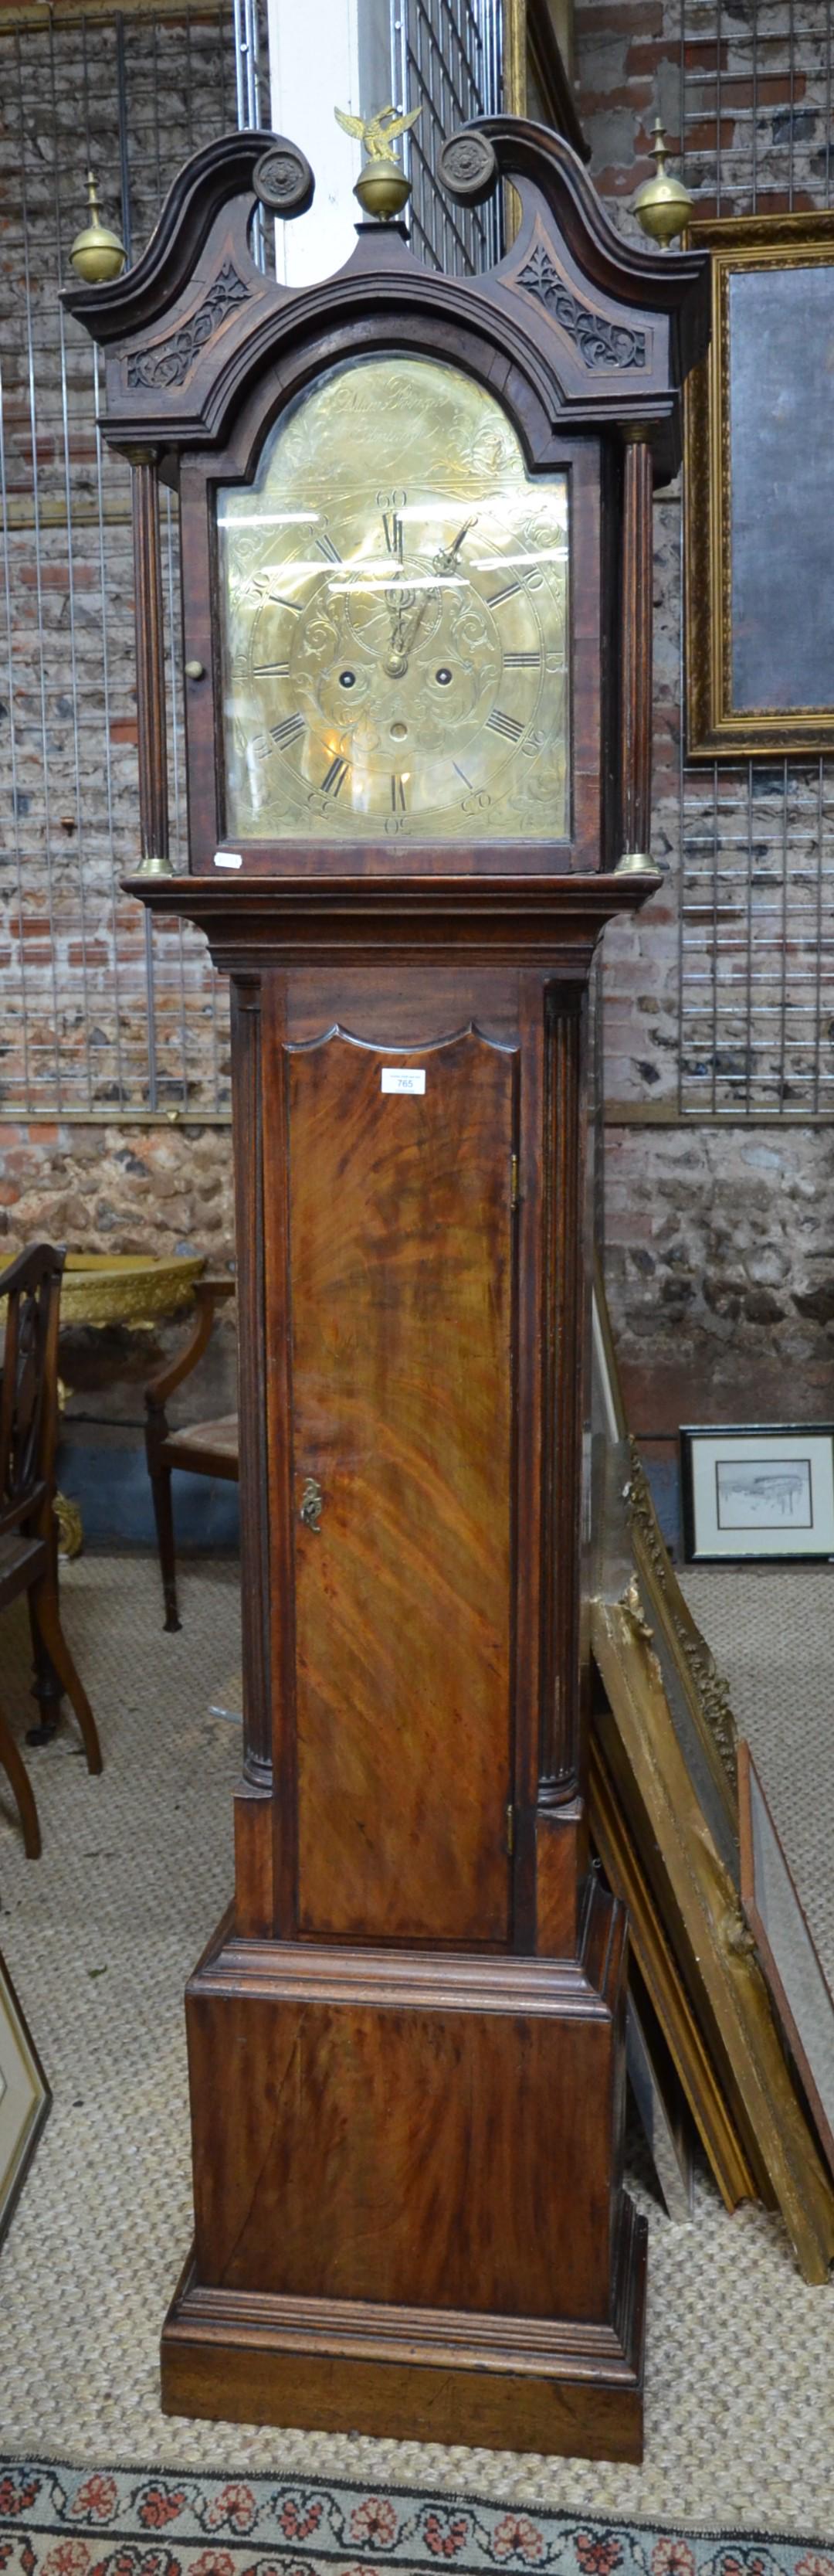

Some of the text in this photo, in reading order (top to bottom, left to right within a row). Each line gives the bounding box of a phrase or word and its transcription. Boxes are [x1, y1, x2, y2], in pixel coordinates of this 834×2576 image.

[376, 489, 408, 508] 60
[241, 572, 270, 603] 50
[522, 567, 545, 592] 10
[503, 652, 541, 671] III
[521, 729, 545, 759] 20
[397, 1079, 414, 1088] 765
